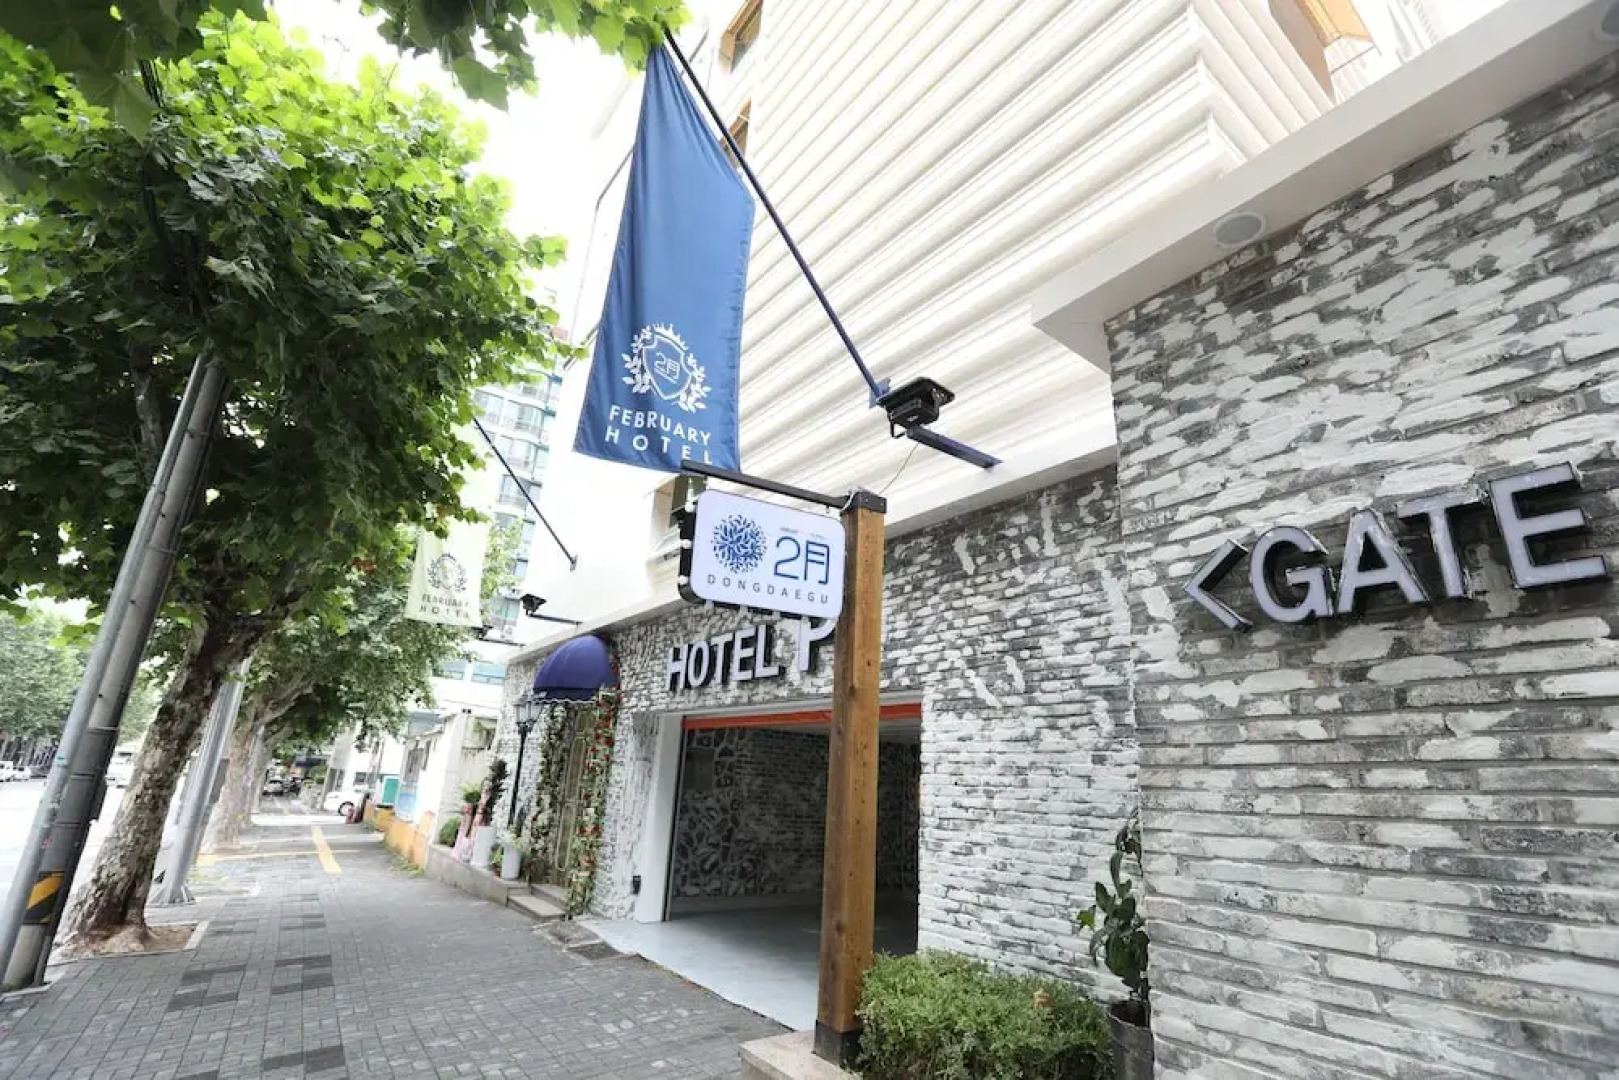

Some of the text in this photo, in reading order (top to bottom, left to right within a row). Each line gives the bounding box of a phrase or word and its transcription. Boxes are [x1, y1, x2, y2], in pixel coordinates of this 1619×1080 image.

[604, 425, 713, 465] HOTEL
[609, 404, 712, 446] FEBRUARY
[773, 535, 830, 585] 2月
[1249, 460, 1608, 624] GATE
[707, 574, 829, 605] DONGDAEGU
[420, 605, 469, 618] HOTEL
[666, 624, 779, 691] HOTEL
